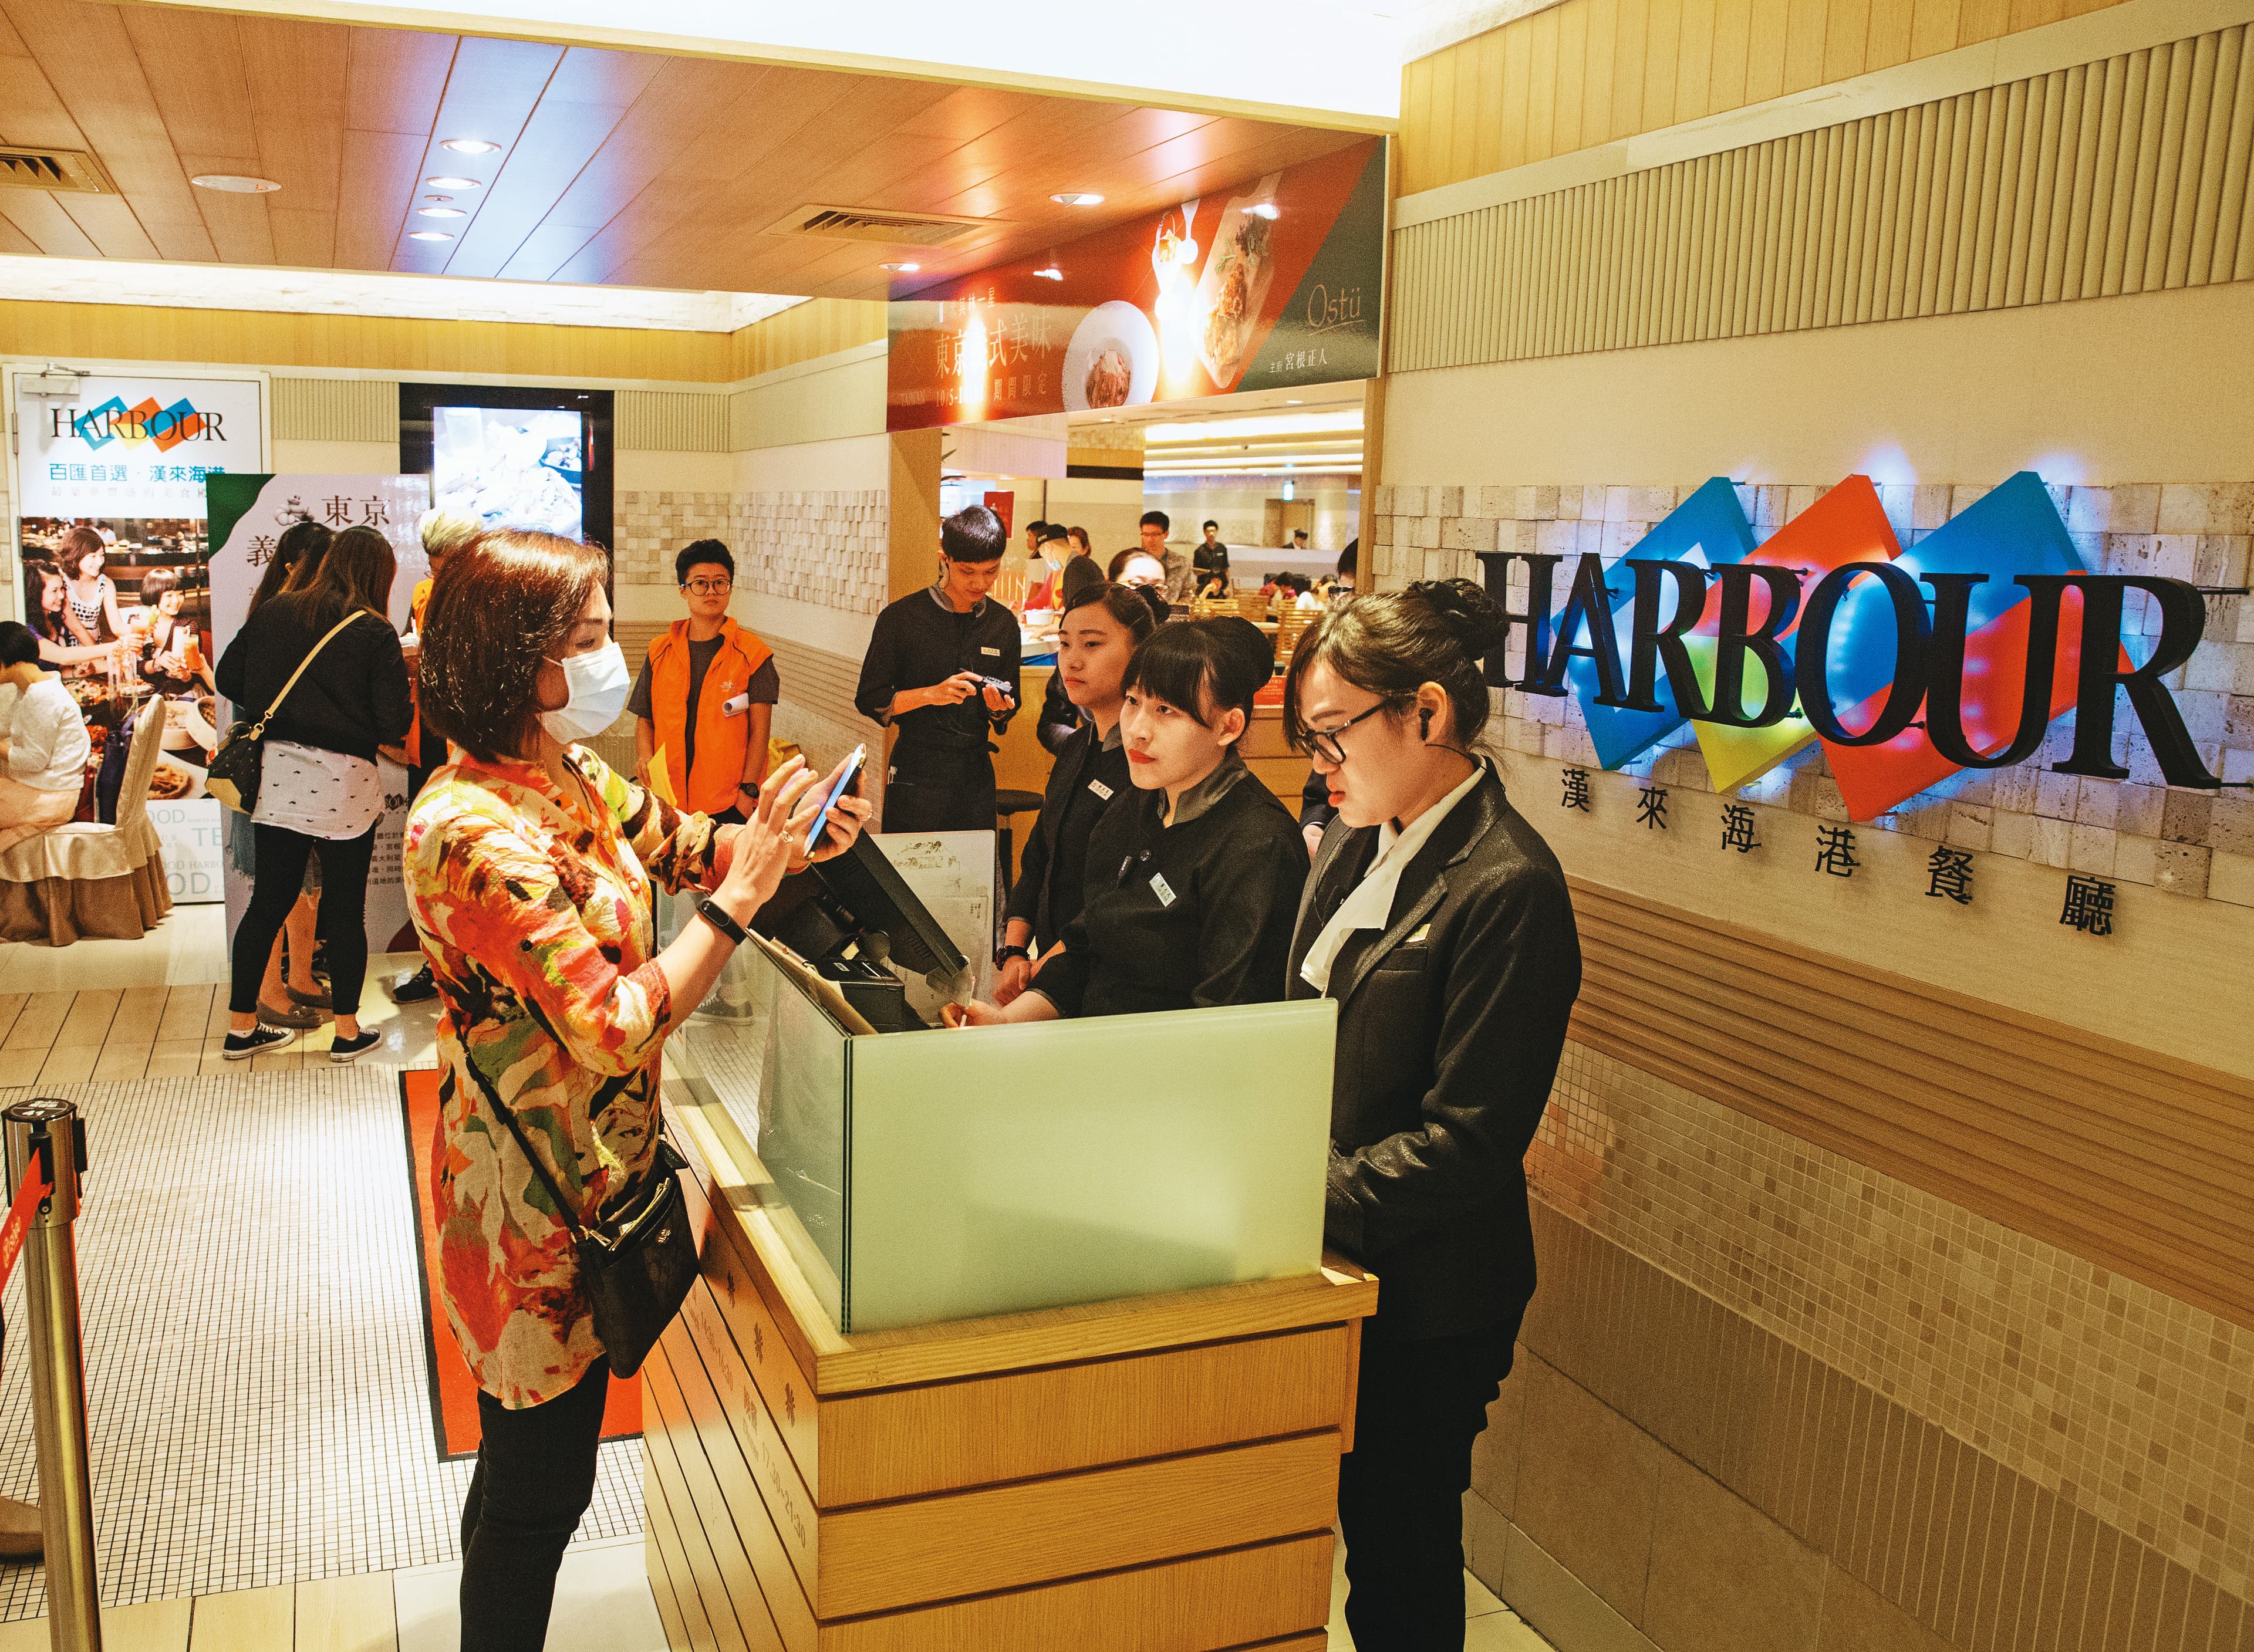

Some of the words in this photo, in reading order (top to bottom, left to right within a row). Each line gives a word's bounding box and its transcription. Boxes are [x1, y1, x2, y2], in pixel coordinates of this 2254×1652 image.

[934, 309, 1052, 379] 東京式美味
[1285, 348, 1328, 371] 宮根正人
[993, 370, 1048, 402] 期間限定
[50, 408, 227, 441] HARBOUR
[49, 463, 127, 482] 百匯首選
[322, 495, 391, 526] 東京
[1475, 550, 2221, 789] HARBOUR
[1561, 768, 2116, 937] 漢來海港餐廳
